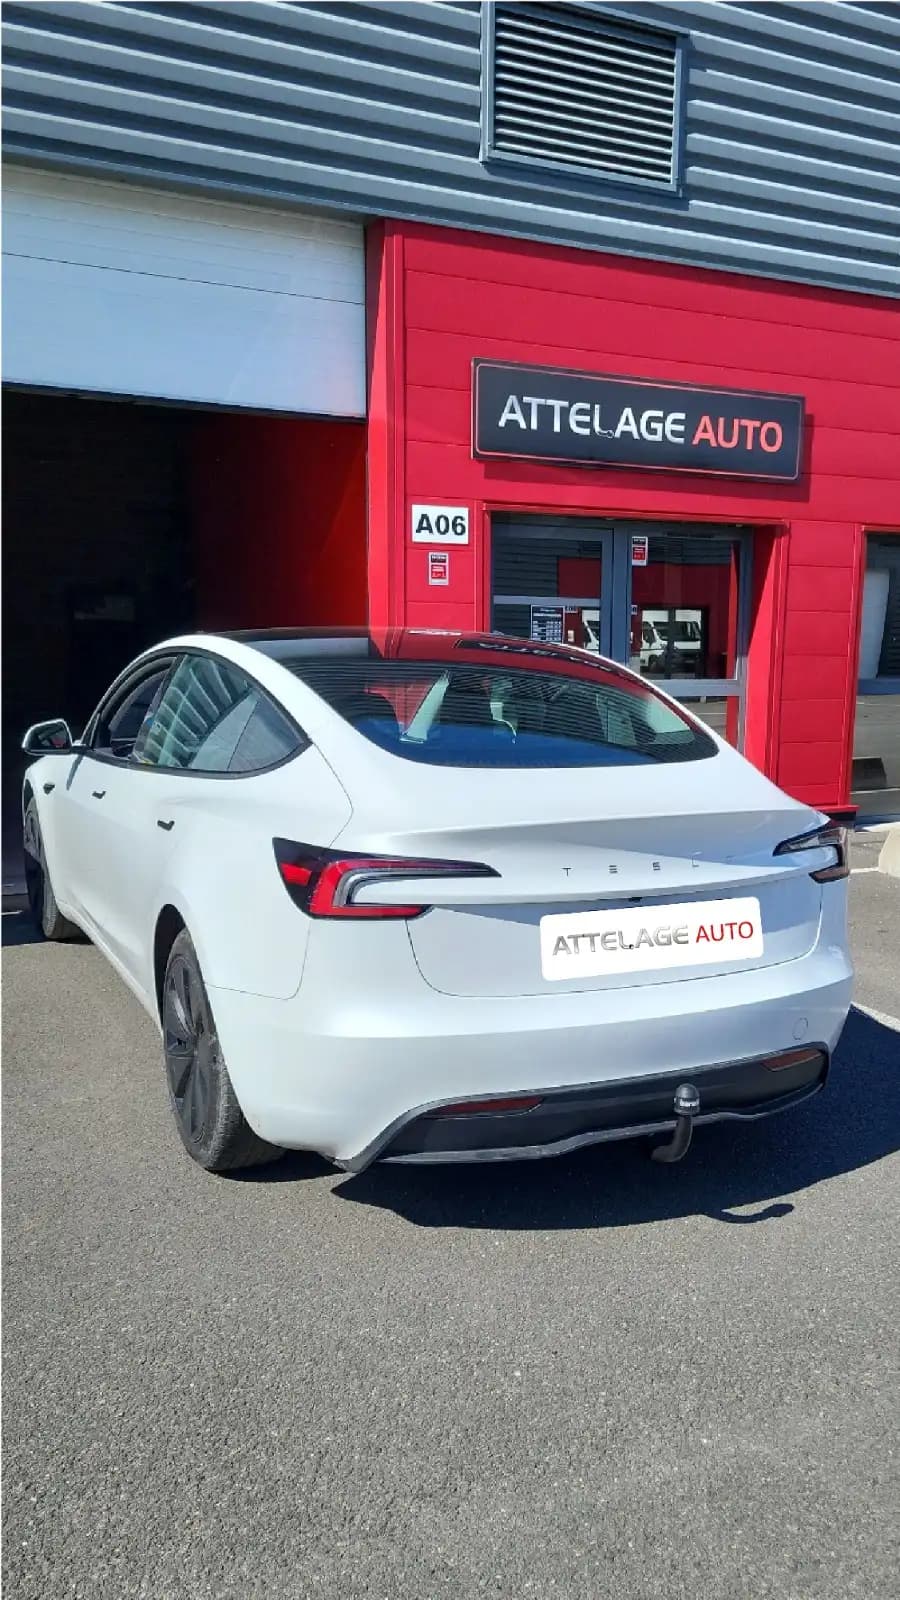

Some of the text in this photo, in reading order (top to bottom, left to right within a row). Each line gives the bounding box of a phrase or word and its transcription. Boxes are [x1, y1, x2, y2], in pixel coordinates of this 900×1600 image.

[498, 395, 783, 453] ATTELAGE AUTO
[415, 513, 467, 536] A06
